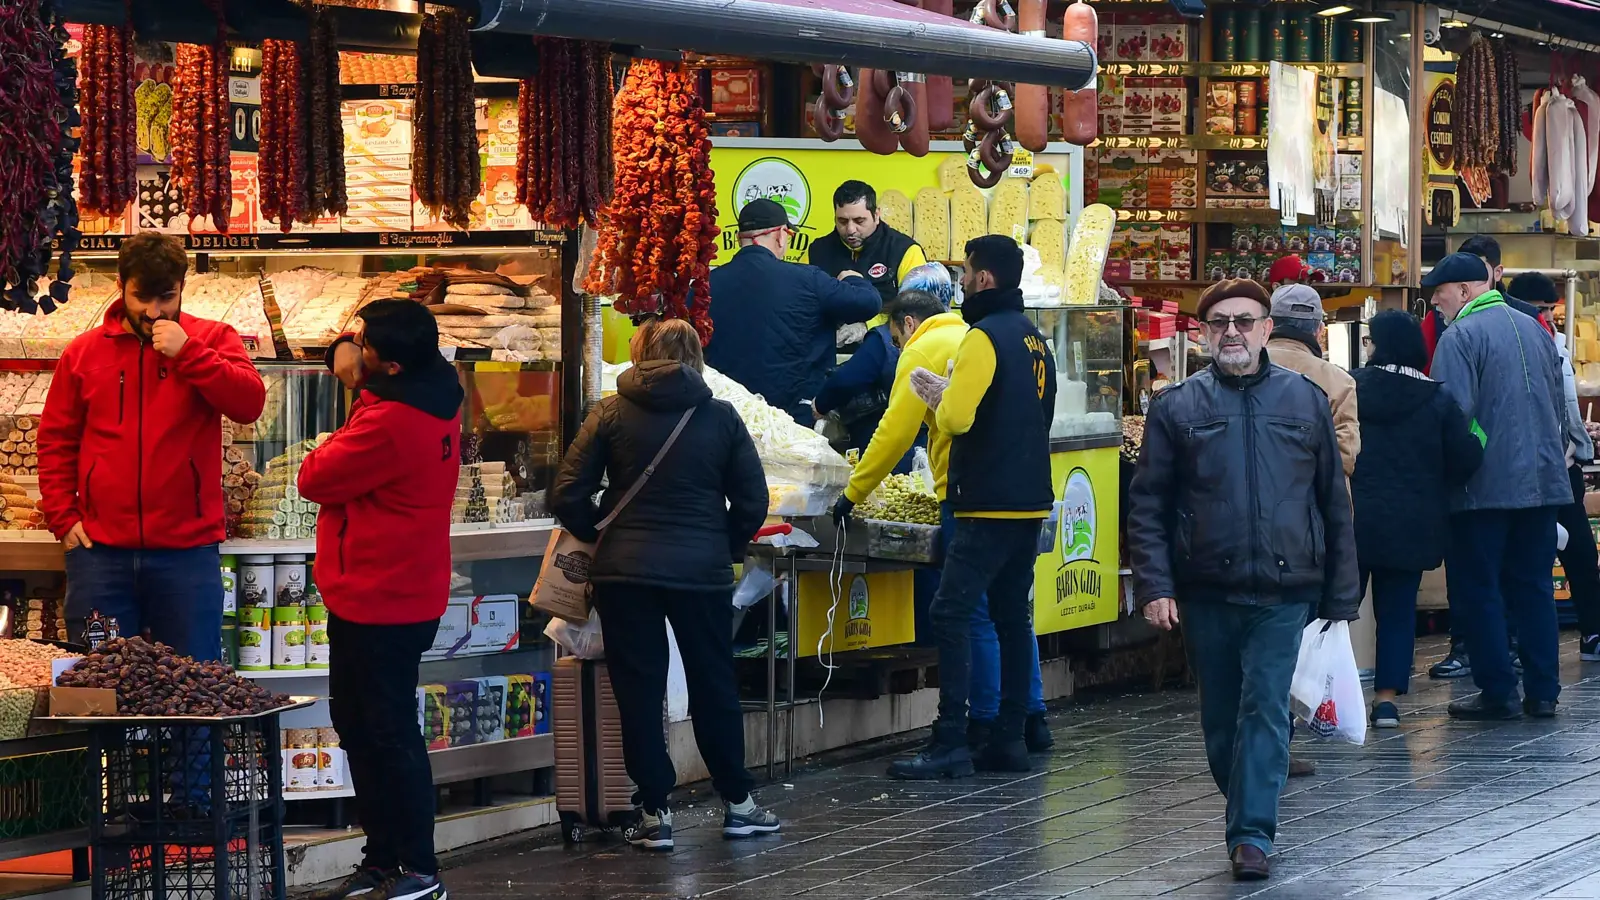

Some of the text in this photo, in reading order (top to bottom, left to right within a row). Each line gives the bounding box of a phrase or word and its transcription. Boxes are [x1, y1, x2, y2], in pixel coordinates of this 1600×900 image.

[1014, 167, 1028, 175] 469
[51, 236, 116, 249] SCIAL
[191, 236, 261, 249] DELIGHT
[390, 232, 454, 248] Bayramoğlu
[1056, 567, 1102, 605] BARIŞ GIDA
[1060, 605, 1078, 617] LEZZET
